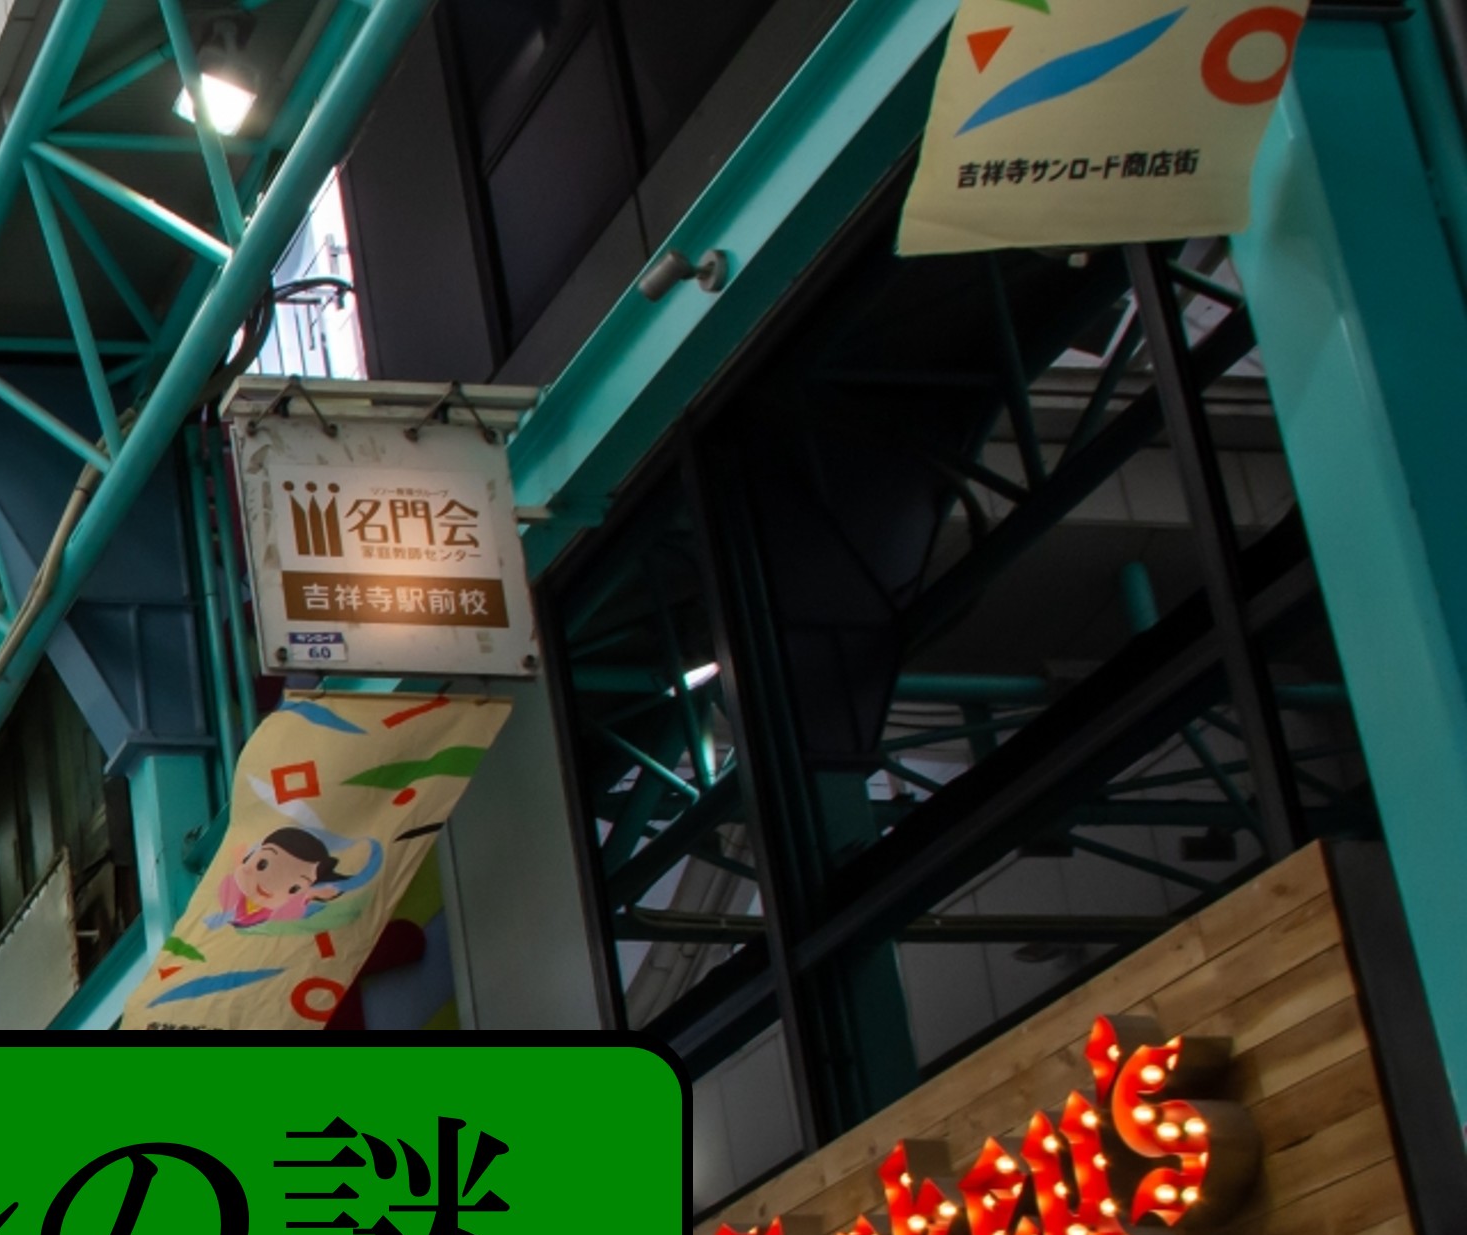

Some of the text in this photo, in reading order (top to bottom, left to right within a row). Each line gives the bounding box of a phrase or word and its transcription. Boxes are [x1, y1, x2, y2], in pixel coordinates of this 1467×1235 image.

[957, 149, 1200, 189] 吉祥寺サンロード商店街
[344, 499, 480, 548] 名門会
[361, 545, 482, 562] 家庭教師センター
[302, 582, 489, 616] 吉祥寺駅前校
